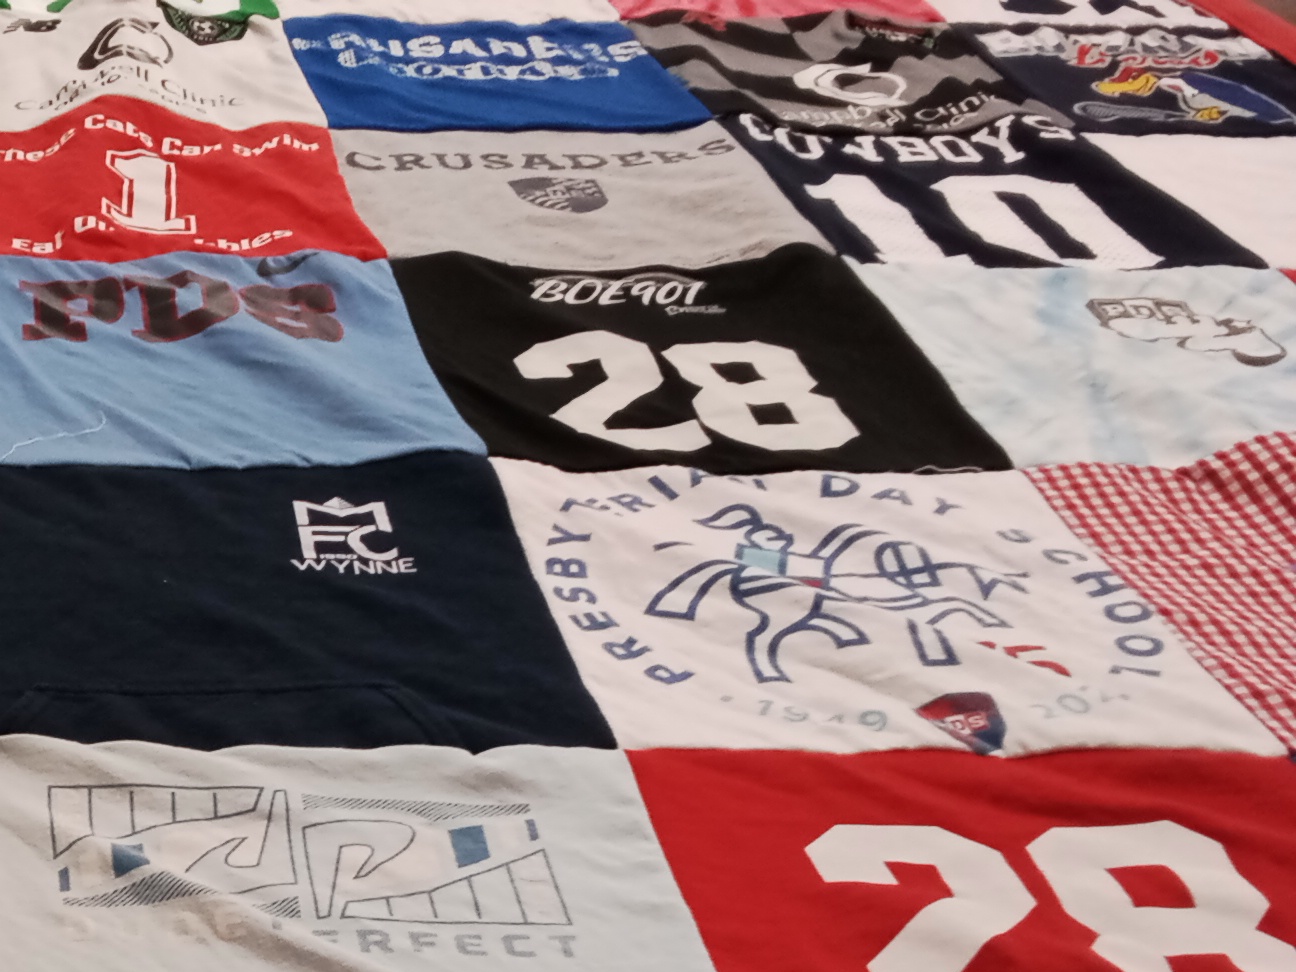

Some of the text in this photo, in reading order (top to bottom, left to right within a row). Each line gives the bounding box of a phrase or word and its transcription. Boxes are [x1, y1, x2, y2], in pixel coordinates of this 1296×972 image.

[84, 114, 154, 148] Cats
[345, 138, 736, 171] CRUSADERS
[101, 148, 197, 235] 1
[804, 174, 1166, 267] 10
[18, 270, 345, 342] PDS
[512, 330, 862, 453] 28
[820, 474, 962, 515] DAY
[290, 557, 418, 575] WYNNE
[271, 920, 577, 958] ERFECT
